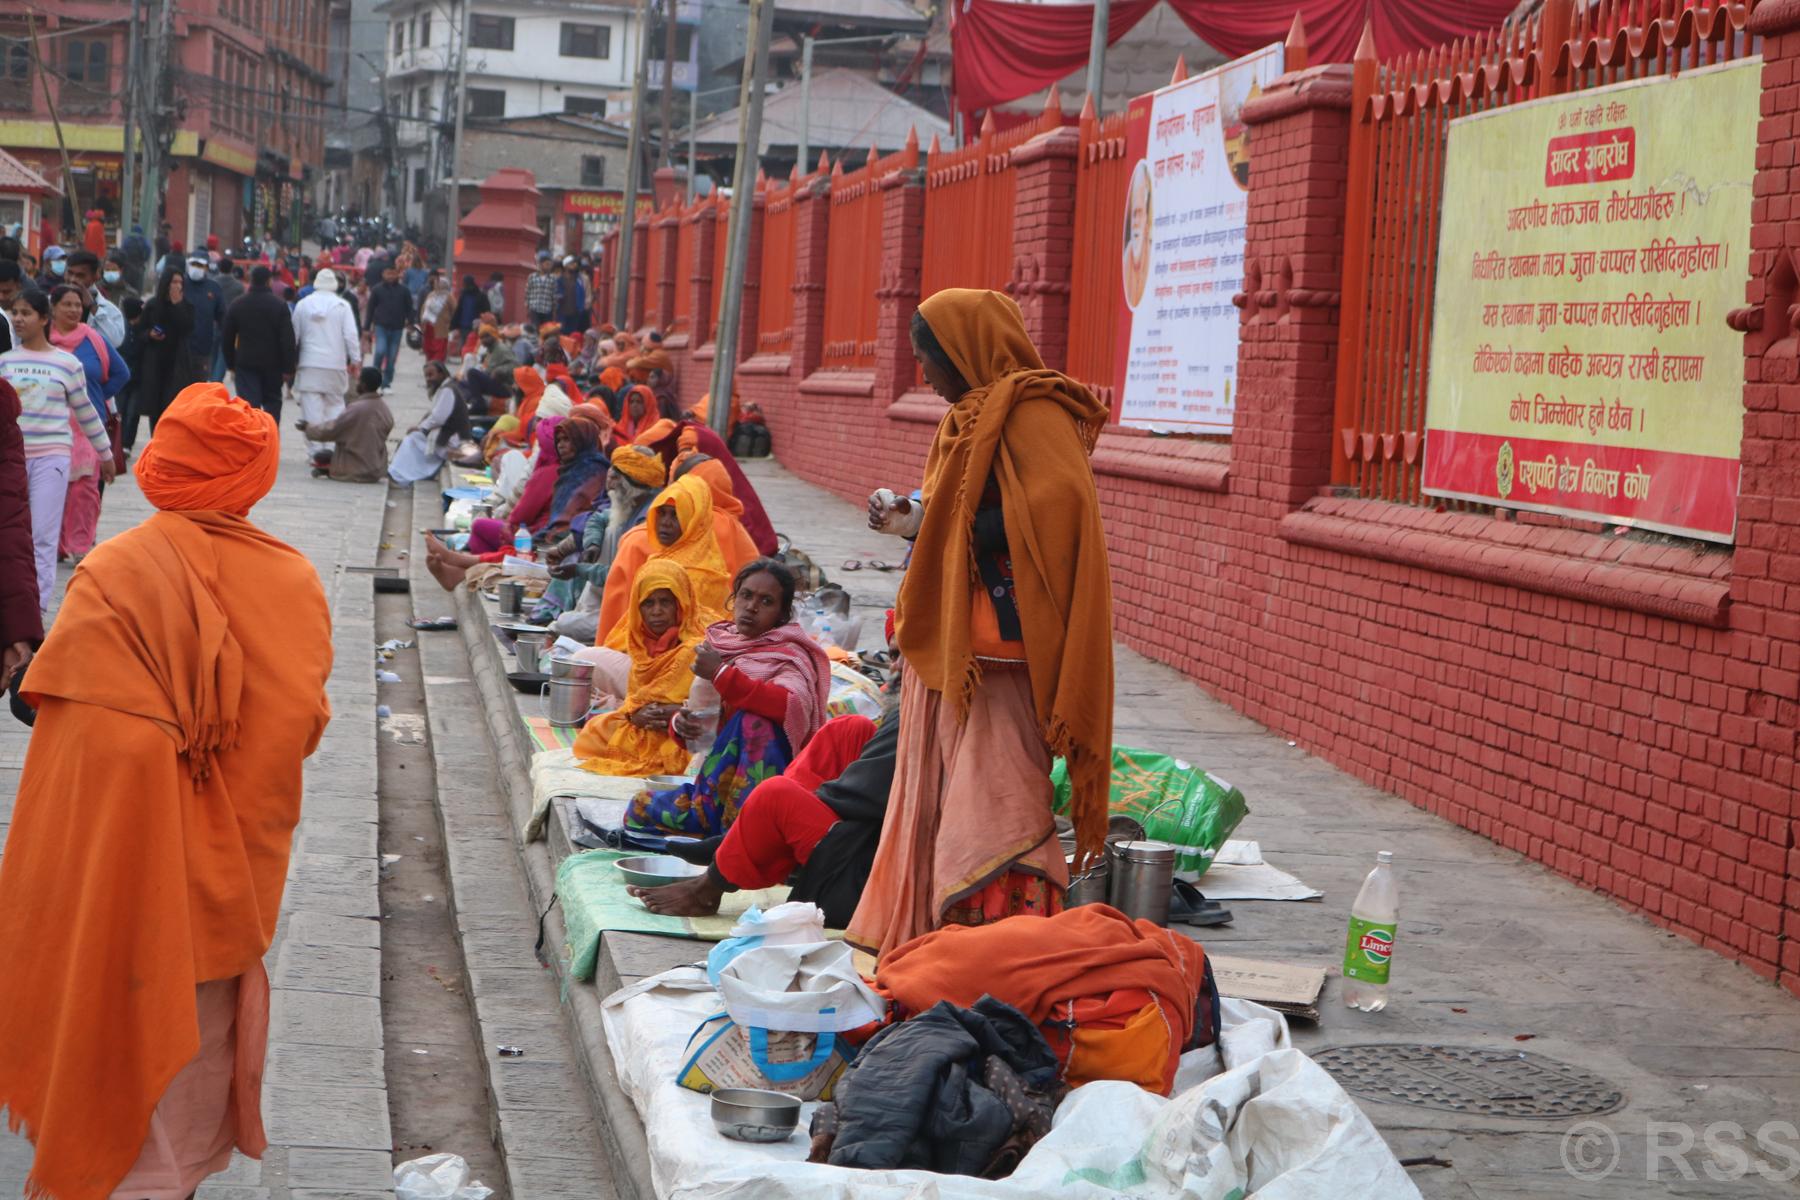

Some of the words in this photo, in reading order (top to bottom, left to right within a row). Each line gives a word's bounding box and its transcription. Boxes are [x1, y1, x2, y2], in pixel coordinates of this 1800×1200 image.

[1550, 147, 1581, 177] सादर
[1584, 136, 1630, 176] अनुरोध
[1507, 199, 1548, 232] आदरणीय
[1472, 251, 1505, 281] निर्धारित
[1508, 252, 1540, 281] स्थानमा
[1542, 250, 1565, 278] मात्र
[1482, 303, 1500, 328] यस
[1501, 302, 1534, 328] स्थानमा
[1601, 292, 1692, 333] नराखिदिनुहोला
[1473, 345, 1512, 375] तोकिएको
[1514, 351, 1544, 376] कक्षमा
[1548, 345, 1583, 378] बाहेक
[1586, 351, 1625, 379] अन्यत्र
[1628, 347, 1660, 380] राखी
[1661, 355, 1705, 384] हराएमा
[1509, 393, 1530, 423] कोष
[1534, 393, 1586, 429] जिम्मेवार
[1588, 397, 1605, 436] हुने
[1608, 397, 1634, 431] छैन
[1519, 454, 1557, 495] पशुपति
[1558, 457, 1580, 493] क्षेत्र
[1580, 457, 1620, 499] विकास
[1623, 464, 1652, 501] कोष
